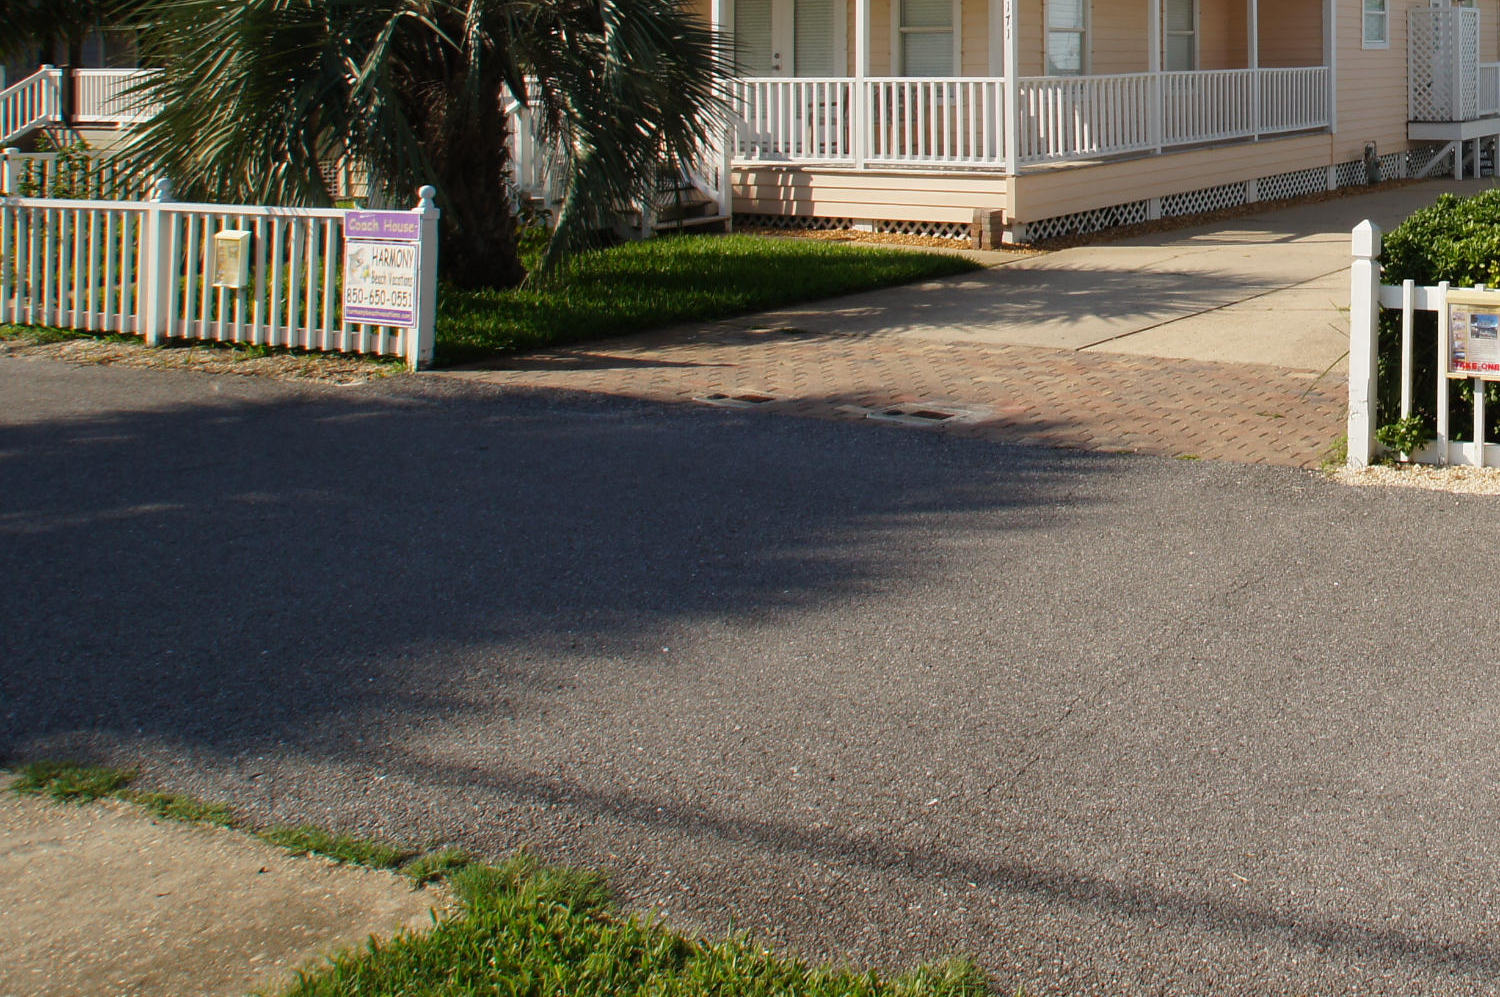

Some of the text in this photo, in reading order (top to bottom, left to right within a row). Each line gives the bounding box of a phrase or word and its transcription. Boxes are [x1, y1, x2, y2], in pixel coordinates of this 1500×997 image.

[349, 218, 415, 233] Coach House
[372, 248, 413, 268] HARMONY
[346, 287, 412, 307] 850-650-0551
[1481, 362, 1500, 371] ONE
